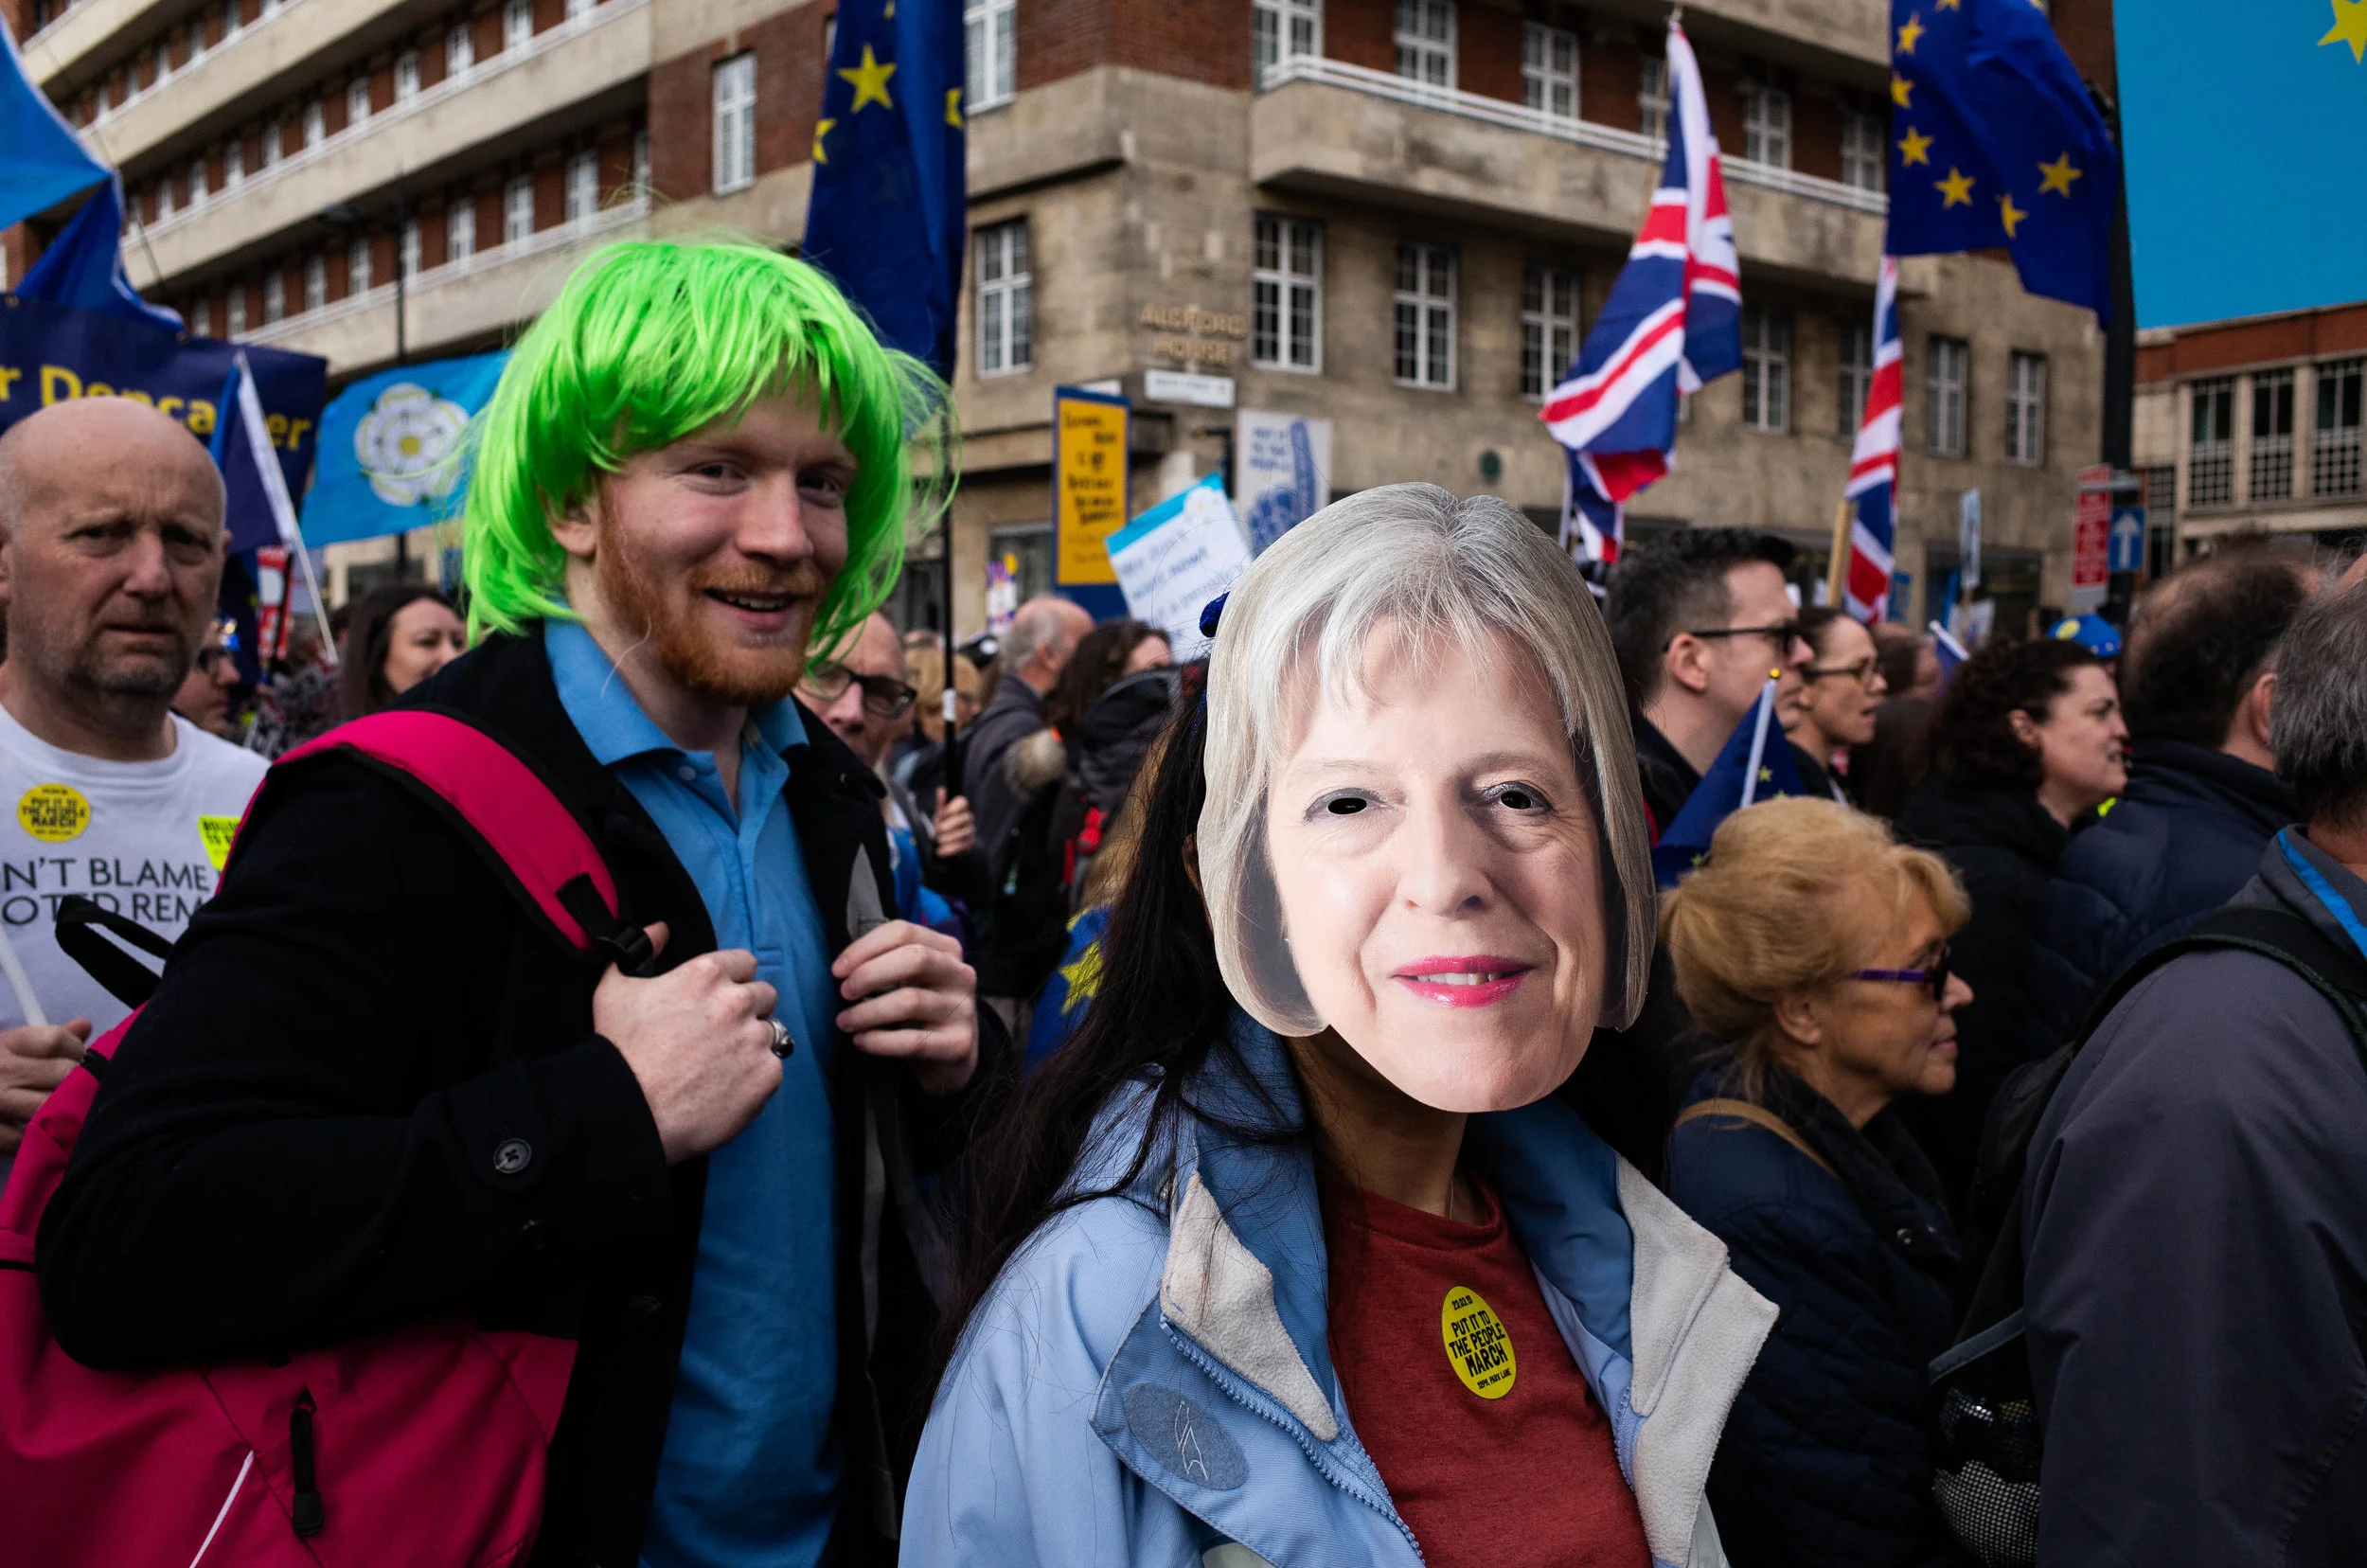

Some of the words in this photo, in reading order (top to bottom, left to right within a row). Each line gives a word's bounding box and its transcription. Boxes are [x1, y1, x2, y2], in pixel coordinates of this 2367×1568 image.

[89, 858, 210, 892] BLAME
[2, 893, 119, 926] OTD
[1448, 1336, 1472, 1359] THE
[1469, 1322, 1505, 1350] PEOPLE
[1450, 1317, 1470, 1338] PUT
[1468, 1312, 1481, 1331] IT
[1477, 1310, 1491, 1326] TO
[1464, 1341, 1508, 1378] MARCH
